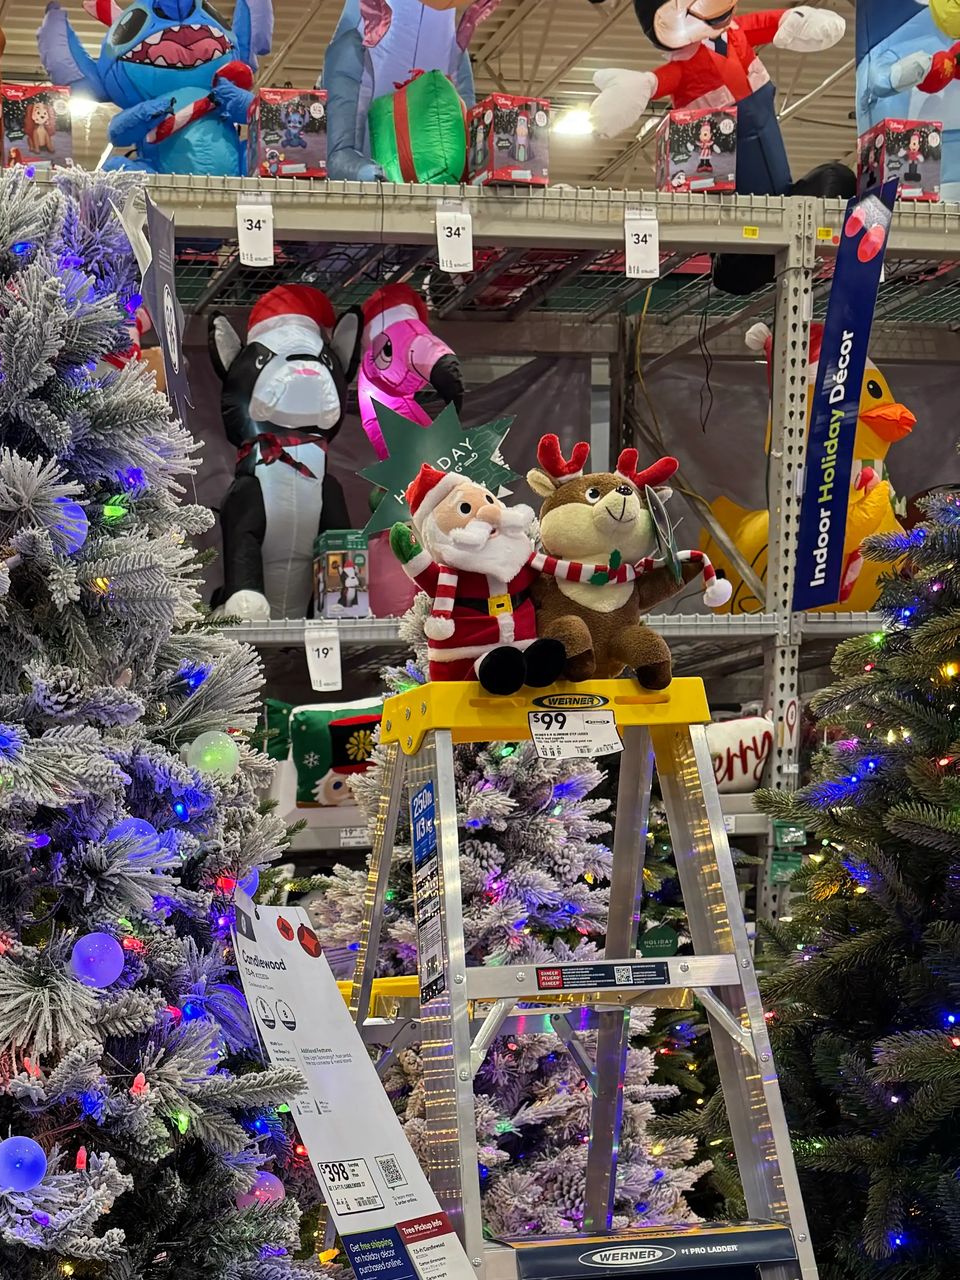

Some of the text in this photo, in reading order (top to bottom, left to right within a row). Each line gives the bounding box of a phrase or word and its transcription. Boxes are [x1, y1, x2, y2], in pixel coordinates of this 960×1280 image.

[810, 330, 854, 588] Indoor Holiday Décor
[393, 437, 473, 505] HDAY
[548, 697, 595, 706] WERNER
[533, 712, 567, 731] $99
[712, 730, 773, 785] erry
[242, 949, 287, 971] Candlewood
[320, 1162, 350, 1183] $398
[402, 1219, 443, 1235] Tree Pickup Info
[349, 1238, 394, 1253] Get free shipping
[423, 1242, 446, 1253] Candlewood
[681, 1245, 738, 1256] #1 PRO LADDER
[354, 1255, 363, 1263] on
[362, 1251, 381, 1262] holiday
[599, 1250, 657, 1262] WERNER
[359, 1262, 385, 1276] purchased
